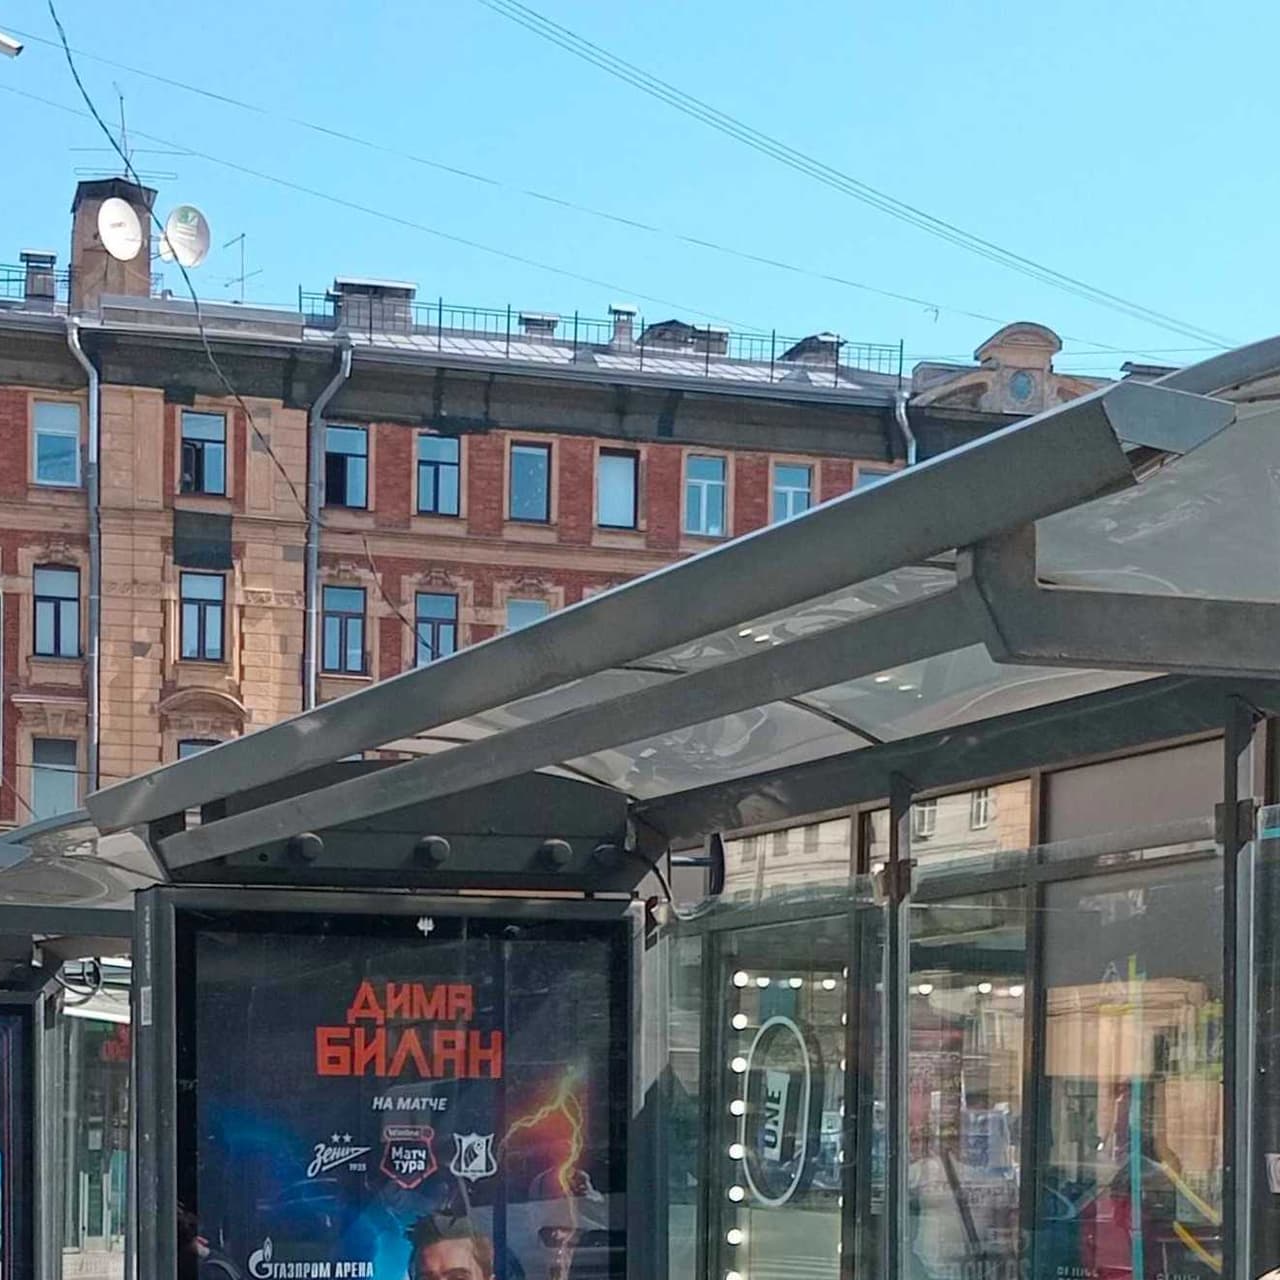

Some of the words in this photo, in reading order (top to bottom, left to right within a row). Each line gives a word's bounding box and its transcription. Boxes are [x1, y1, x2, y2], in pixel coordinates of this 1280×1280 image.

[372, 1096, 396, 1111] НА
[397, 1097, 448, 1112] МАТЧЕ
[391, 1145, 426, 1160] Матч
[393, 1159, 426, 1174] тура
[273, 1261, 331, 1279] ГАЗПРОМ
[335, 1261, 374, 1279] АРЕНА
